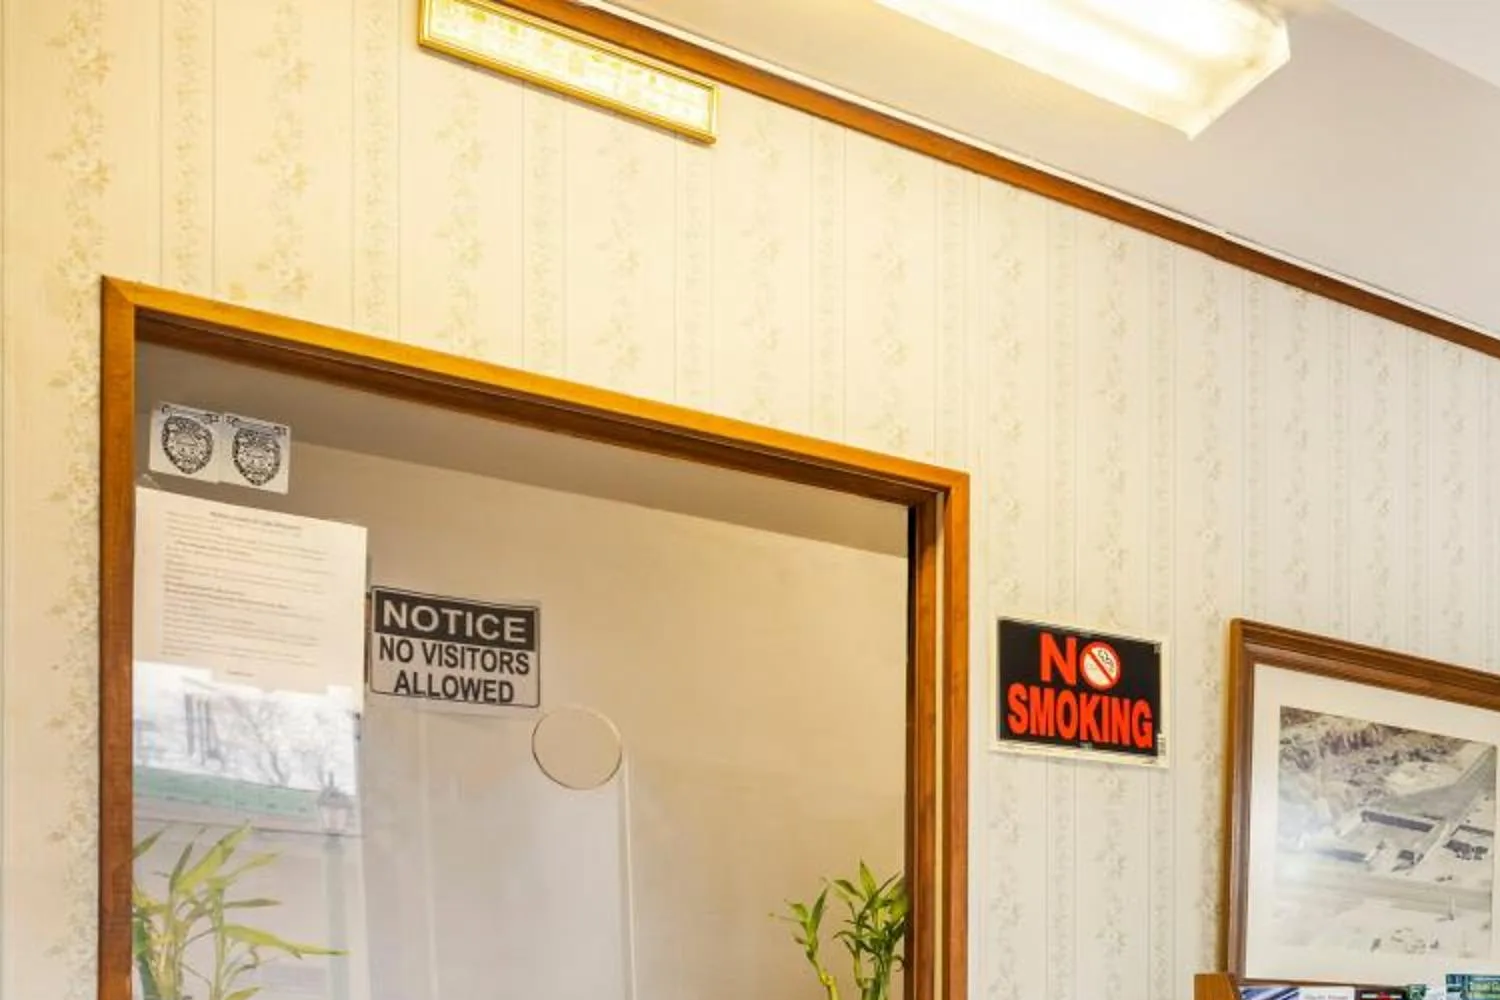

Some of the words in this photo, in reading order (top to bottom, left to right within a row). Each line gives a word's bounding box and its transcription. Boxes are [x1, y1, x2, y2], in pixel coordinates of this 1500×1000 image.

[383, 600, 527, 643] NOTICE
[379, 636, 414, 663] NO
[421, 642, 530, 675] VISITORS
[394, 670, 515, 703] ALLOWED
[1007, 683, 1153, 748] SMOKING
